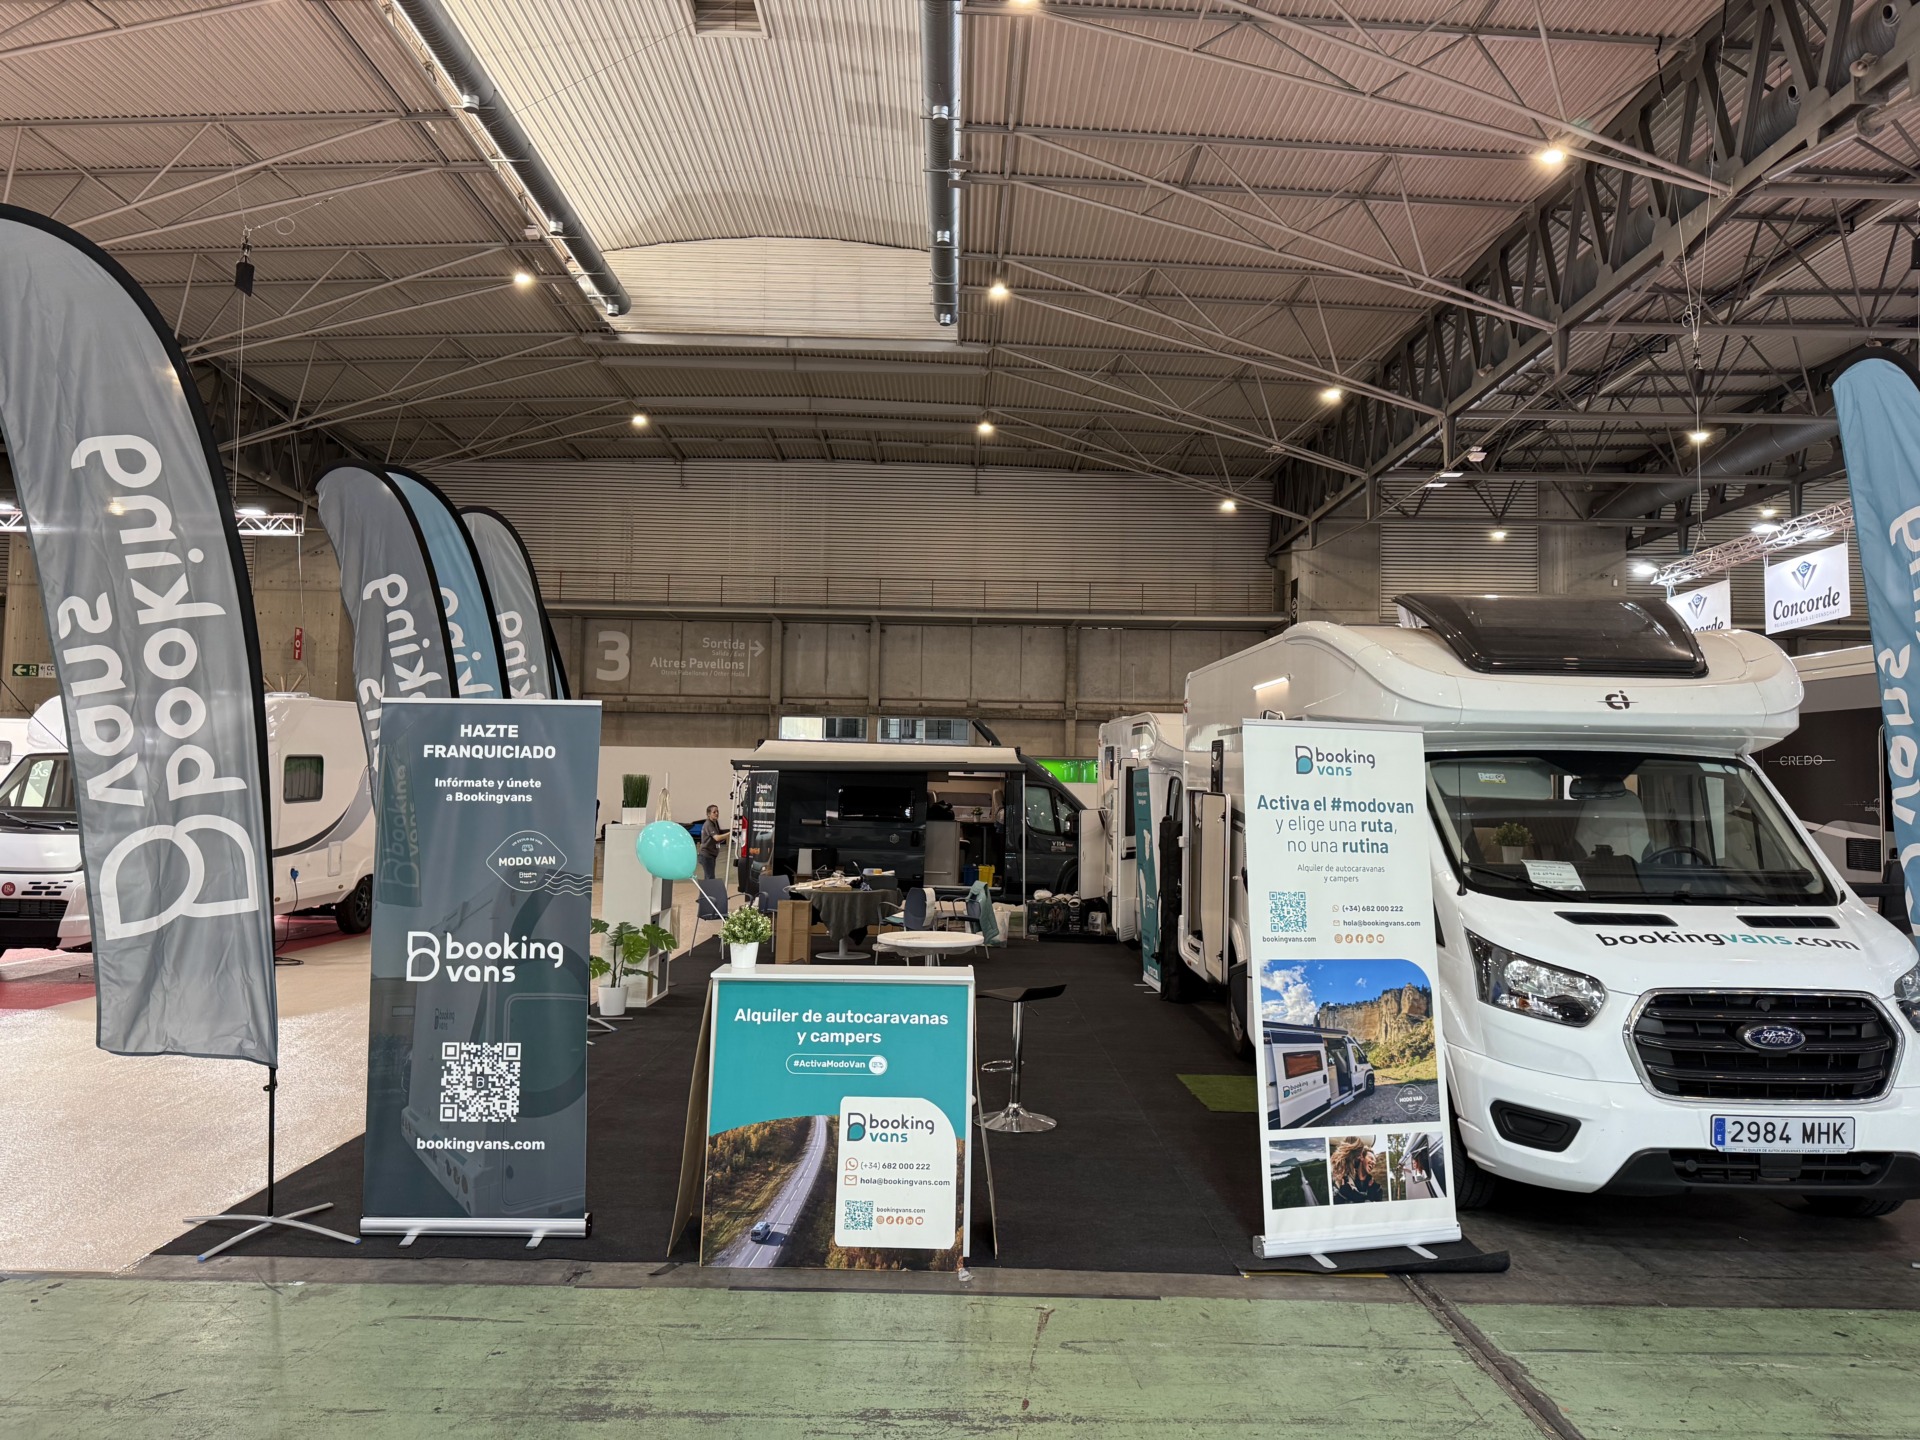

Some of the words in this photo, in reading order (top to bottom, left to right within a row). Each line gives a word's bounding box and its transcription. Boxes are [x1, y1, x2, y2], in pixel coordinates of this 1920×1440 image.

[1773, 585, 1840, 620] Concorde
[702, 637, 745, 650] Sortida
[596, 630, 631, 682] 3
[650, 656, 687, 669] Altres
[689, 657, 745, 670] Pavellons
[460, 724, 519, 739] HAZTE
[423, 744, 557, 760] FRANQUICIADO
[1315, 746, 1376, 769] booking
[1779, 755, 1824, 767] CREDO
[1316, 765, 1353, 777] vans
[434, 777, 495, 789] Infórmate
[497, 779, 505, 790] y
[507, 777, 542, 788] únete
[445, 793, 453, 802] a
[455, 791, 533, 804] Bookingvans
[1257, 794, 1310, 811] Activa
[1313, 796, 1327, 811] el
[1330, 797, 1415, 814] #modovan
[1275, 818, 1284, 834] y
[1288, 815, 1325, 835] elige
[1329, 818, 1357, 832] una
[1361, 817, 1398, 835] ruta,
[1287, 839, 1307, 853] no
[1311, 839, 1338, 853] una
[1342, 838, 1389, 854] rutina
[498, 856, 532, 867] MODO
[534, 855, 556, 865] VAN
[1297, 864, 1324, 873] Alquiler
[1325, 864, 1334, 872] de
[1335, 864, 1385, 873] autocaravanas
[1323, 875, 1329, 883] y
[1329, 874, 1360, 883] campers
[1341, 904, 1361, 913] (+34)
[1361, 905, 1376, 913] 682
[1376, 905, 1390, 913] 000
[1390, 905, 1404, 913] 222
[1342, 918, 1421, 928] hola@bookingvans.com
[1262, 935, 1317, 943] bookingvans.com
[1597, 930, 1862, 951] bookingvans.com
[445, 931, 564, 969] booking
[446, 963, 516, 983] vans
[734, 1008, 799, 1025] Alquiler
[802, 1009, 823, 1023] de
[826, 1009, 949, 1025] autocaravanas
[796, 1031, 808, 1045] y
[810, 1031, 882, 1046] campers
[1757, 1029, 1795, 1045] Ford
[793, 1059, 866, 1069] #ActivaModoVan
[869, 1113, 935, 1136] booking
[1730, 1120, 1792, 1144] 2984
[1801, 1122, 1846, 1144] MHK
[869, 1130, 908, 1143] vans
[417, 1137, 546, 1153] bookingvans.com
[860, 1161, 881, 1170] (+34)
[882, 1162, 897, 1170] 682
[898, 1162, 915, 1170] 000
[915, 1163, 931, 1171] 222
[860, 1177, 951, 1187] hola@bookingvans.com
